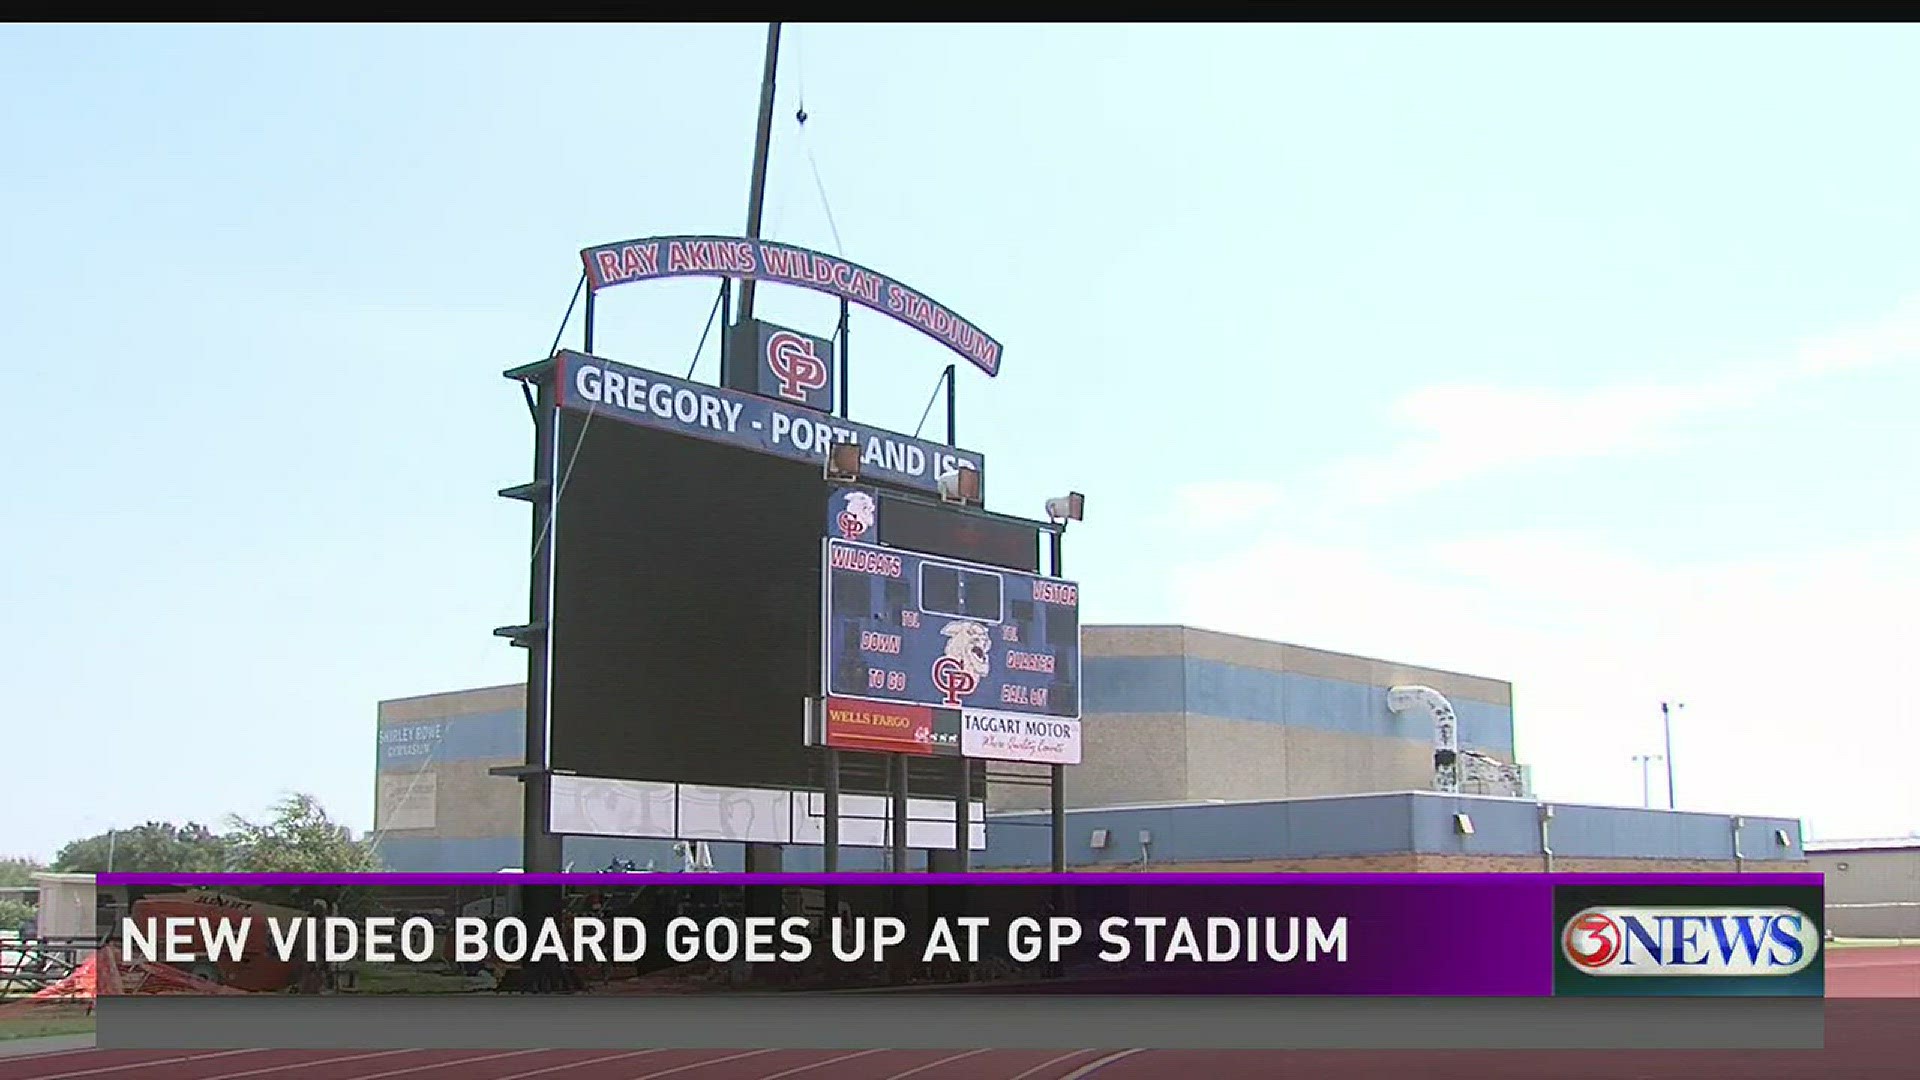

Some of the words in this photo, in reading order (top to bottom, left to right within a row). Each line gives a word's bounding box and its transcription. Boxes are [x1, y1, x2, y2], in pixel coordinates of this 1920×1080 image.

[597, 244, 659, 283] RAY
[668, 240, 757, 273] AKINS
[760, 246, 881, 301] WILDCAT
[888, 286, 997, 368] STADIUM
[576, 365, 742, 433] GREGORY
[831, 545, 902, 578] WILDCATS
[1032, 580, 1077, 606] VISITOR
[861, 630, 901, 654] DOWN
[829, 710, 871, 724] WELLS
[872, 715, 910, 728] FARGO
[964, 715, 1021, 734] TAGGART
[1025, 721, 1071, 738] MOTOR
